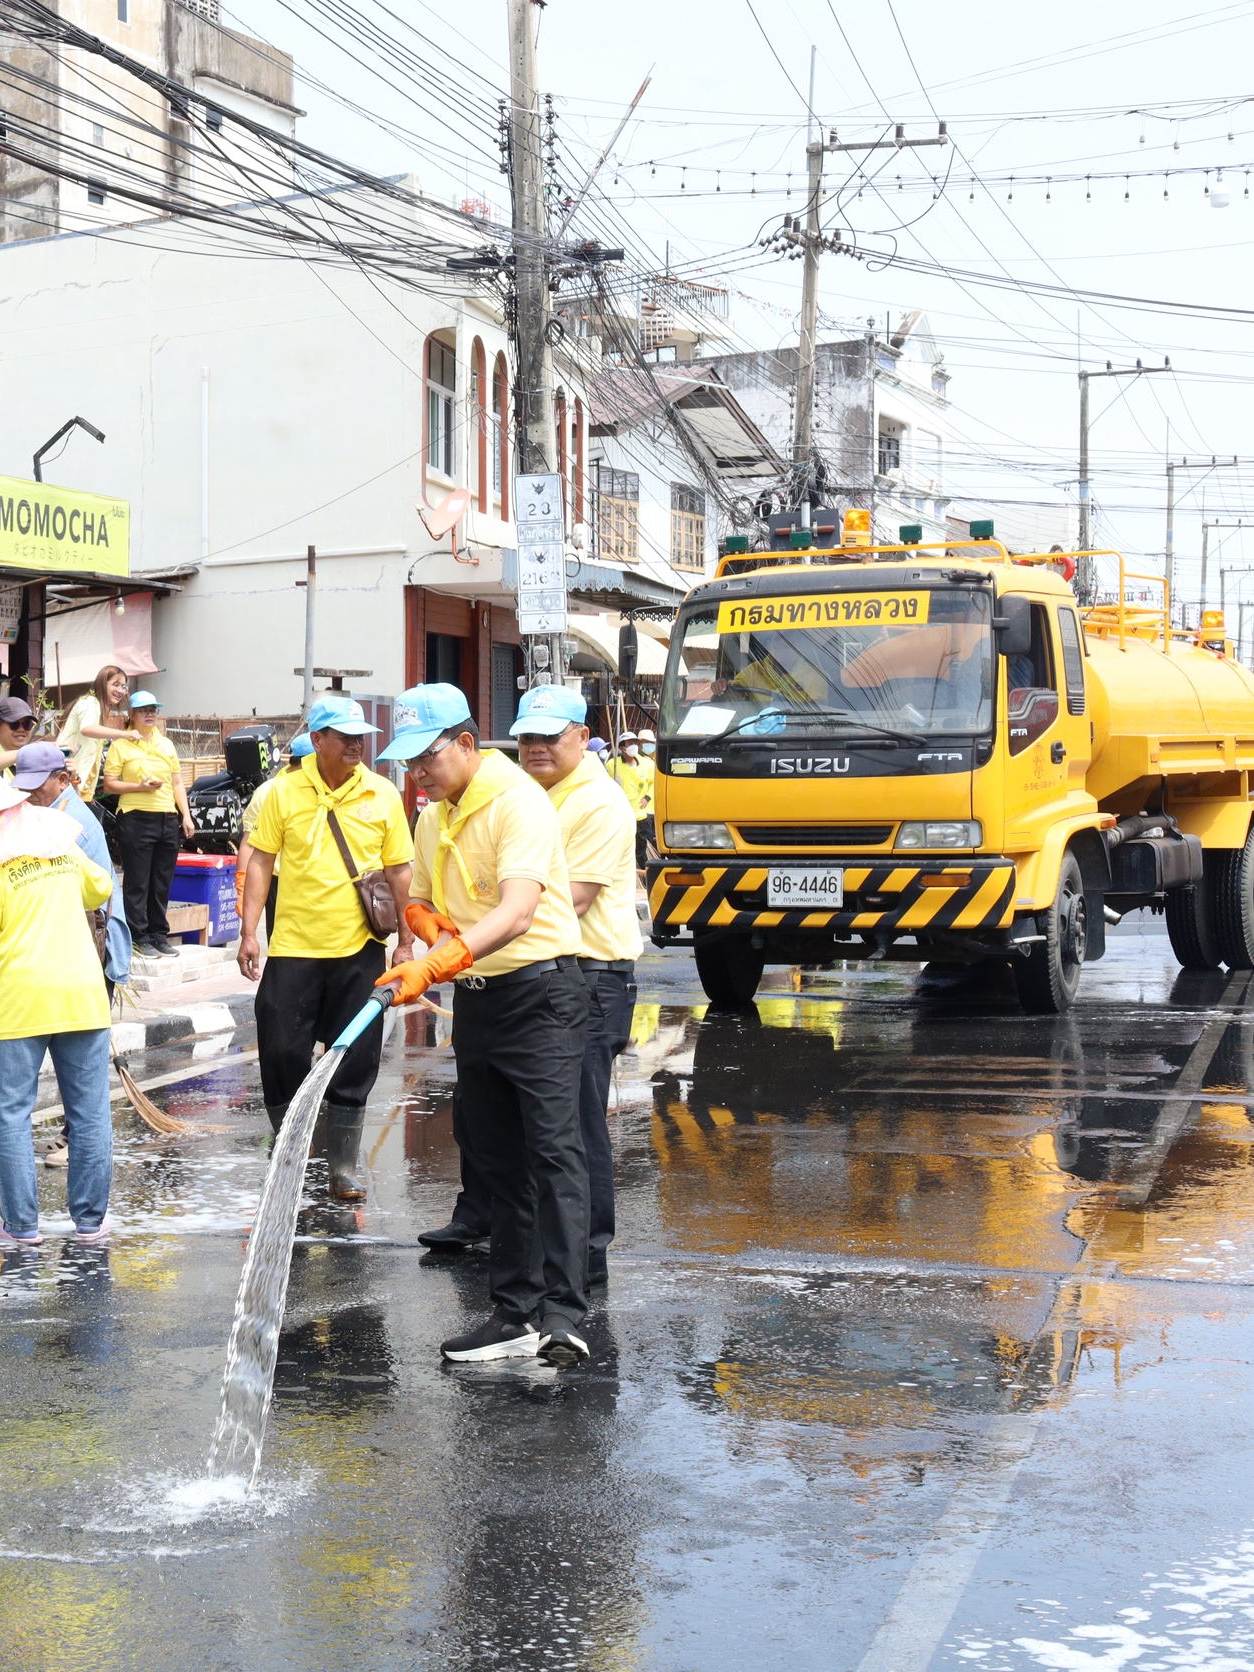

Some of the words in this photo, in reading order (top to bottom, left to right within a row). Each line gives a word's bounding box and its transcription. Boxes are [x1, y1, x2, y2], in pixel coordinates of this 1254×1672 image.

[14, 542, 94, 564] タピオカミルクティー
[730, 597, 919, 627] กรมทางหลวง
[1010, 728, 1028, 736] FTR
[770, 757, 850, 774] ISUZU
[917, 753, 964, 761] FTR
[772, 875, 838, 894] 96-4446
